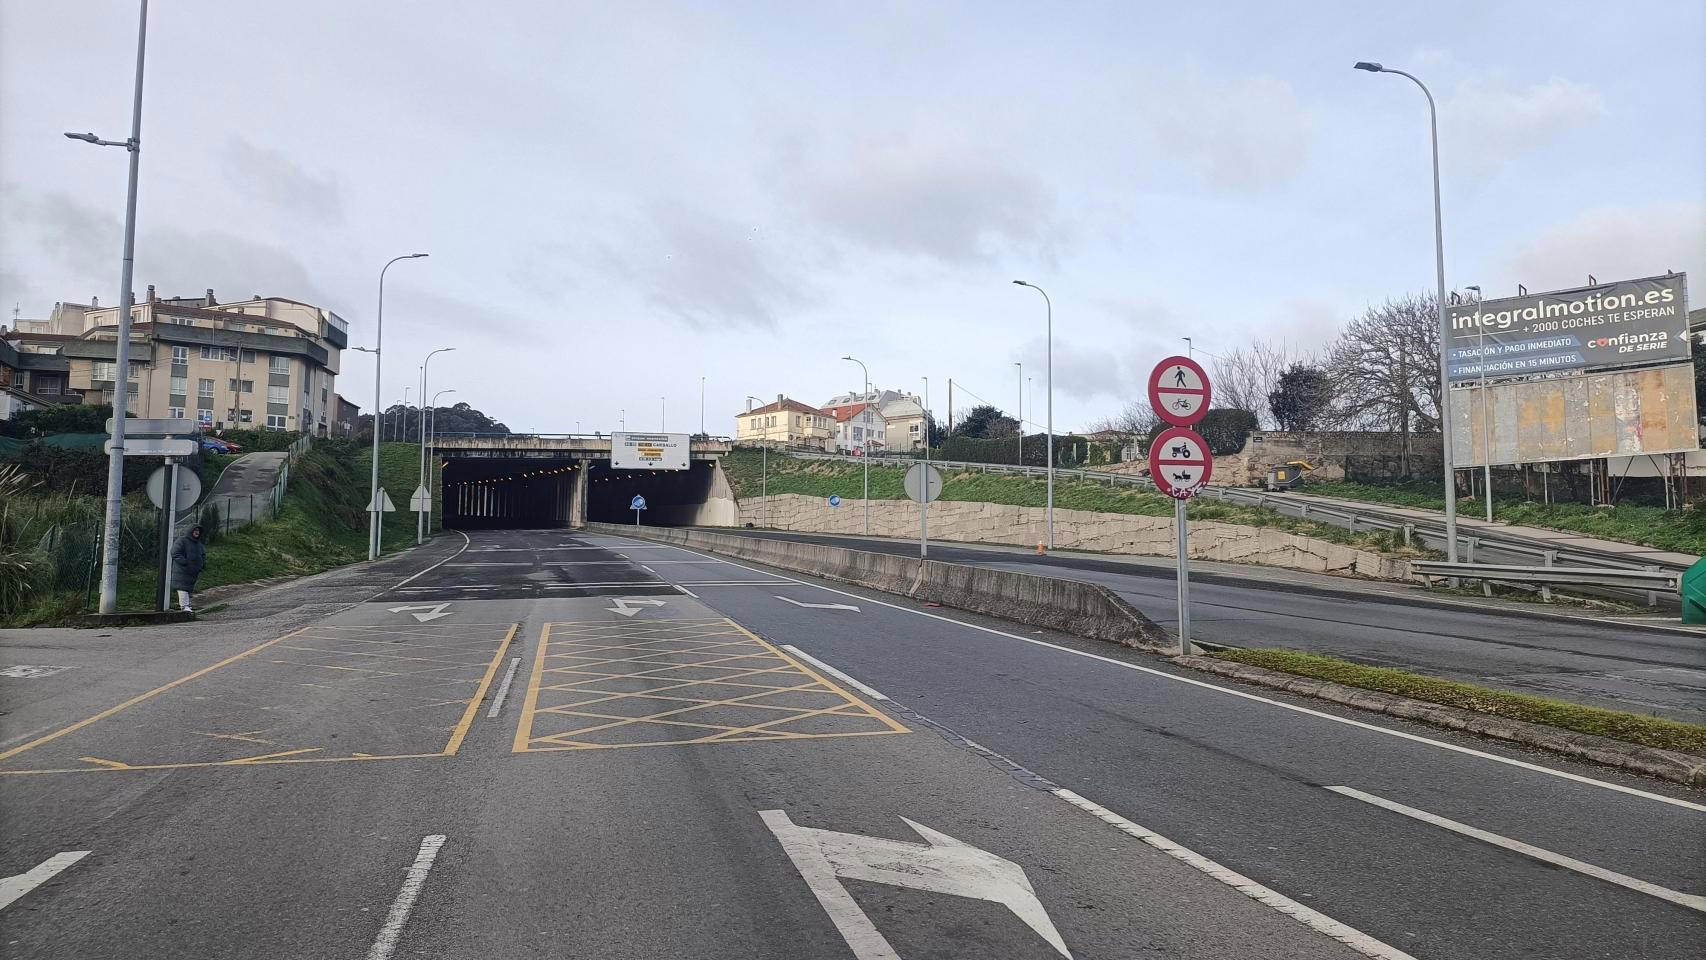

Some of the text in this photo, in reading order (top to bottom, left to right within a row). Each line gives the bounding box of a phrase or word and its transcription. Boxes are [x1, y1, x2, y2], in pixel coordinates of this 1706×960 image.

[1451, 288, 1674, 330] integralmotion.es
[1532, 322, 1559, 333] 2000
[1561, 315, 1605, 329] COCHES
[1607, 313, 1621, 323] TE
[1623, 306, 1675, 321] ESPERAN
[1458, 347, 1496, 358] TASACÓN
[1504, 343, 1526, 353] PAGO
[1527, 338, 1572, 350] INMEDIATO
[1618, 341, 1668, 353] DE SERIE
[1515, 360, 1526, 368] EN
[1528, 358, 1537, 366] 15
[1539, 354, 1577, 365] MINUTOS
